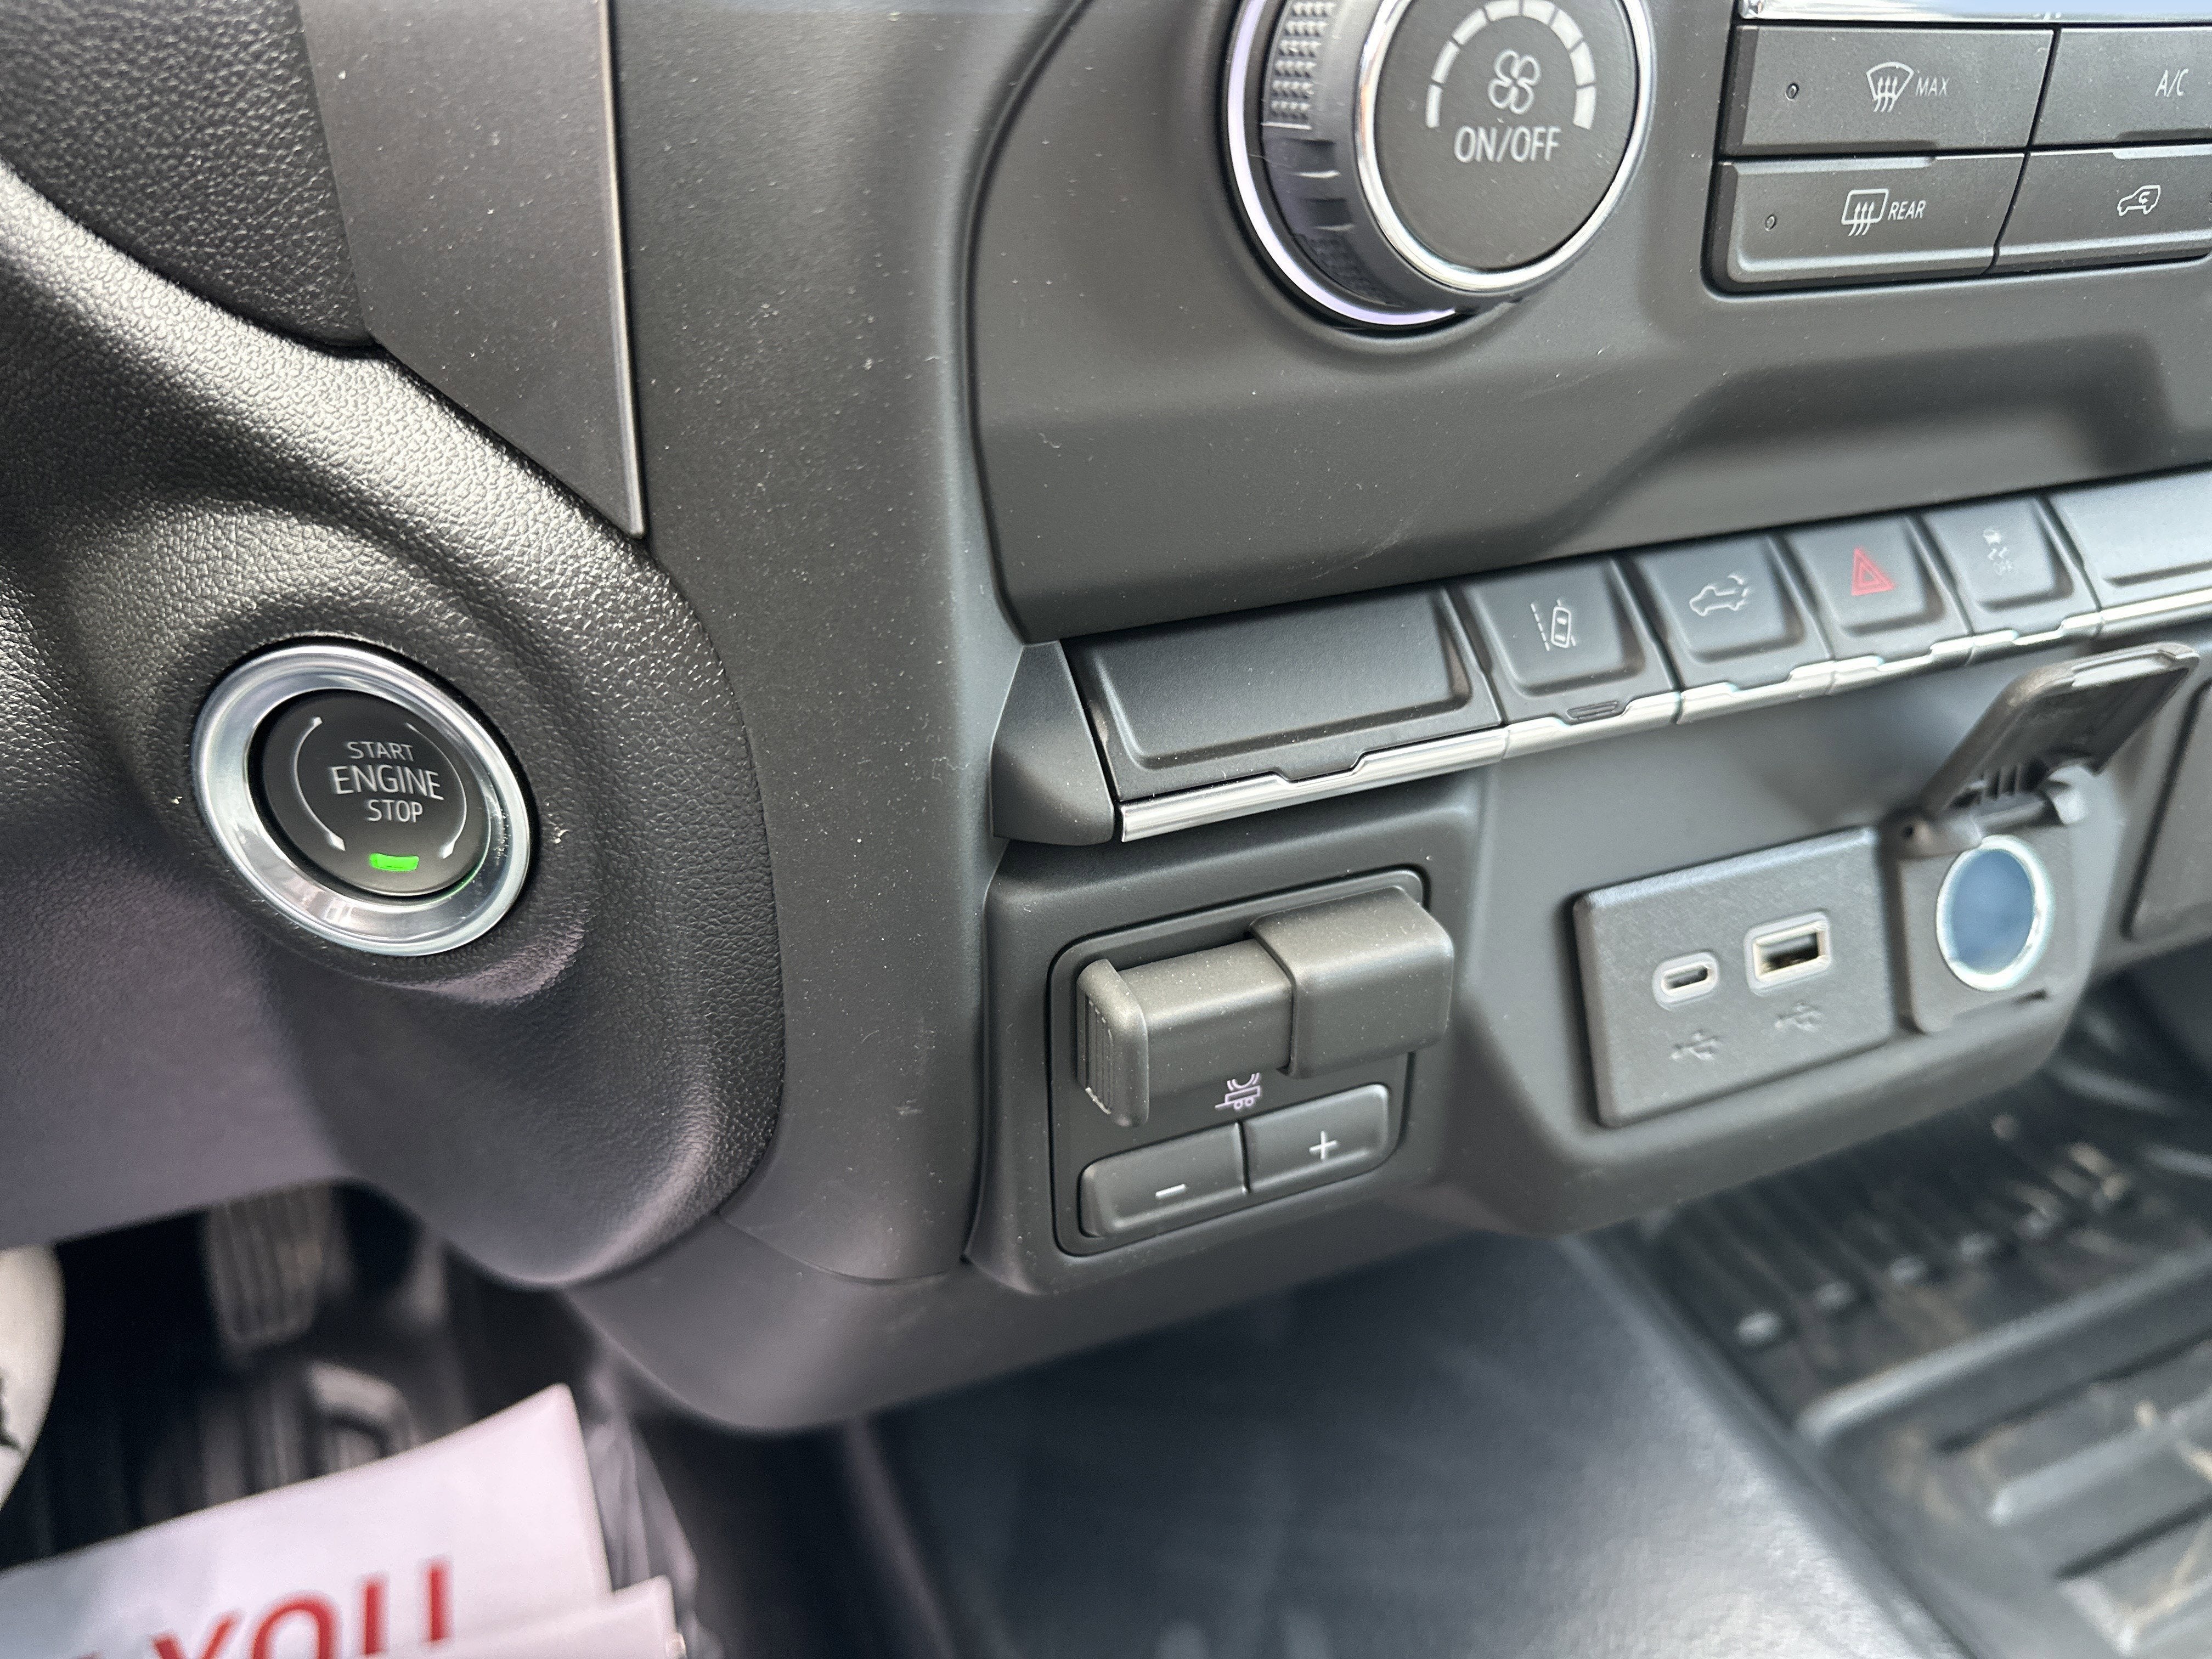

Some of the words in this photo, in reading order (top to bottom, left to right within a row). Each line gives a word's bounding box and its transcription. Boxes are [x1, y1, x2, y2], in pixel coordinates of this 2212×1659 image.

[1915, 76, 1950, 97] MAX
[2154, 68, 2189, 97] A/C
[1454, 125, 1562, 163] ON/OFF
[1887, 200, 1927, 221] REAR
[346, 741, 414, 762] START
[329, 764, 444, 801] ENGINE
[365, 799, 424, 823] STOP
